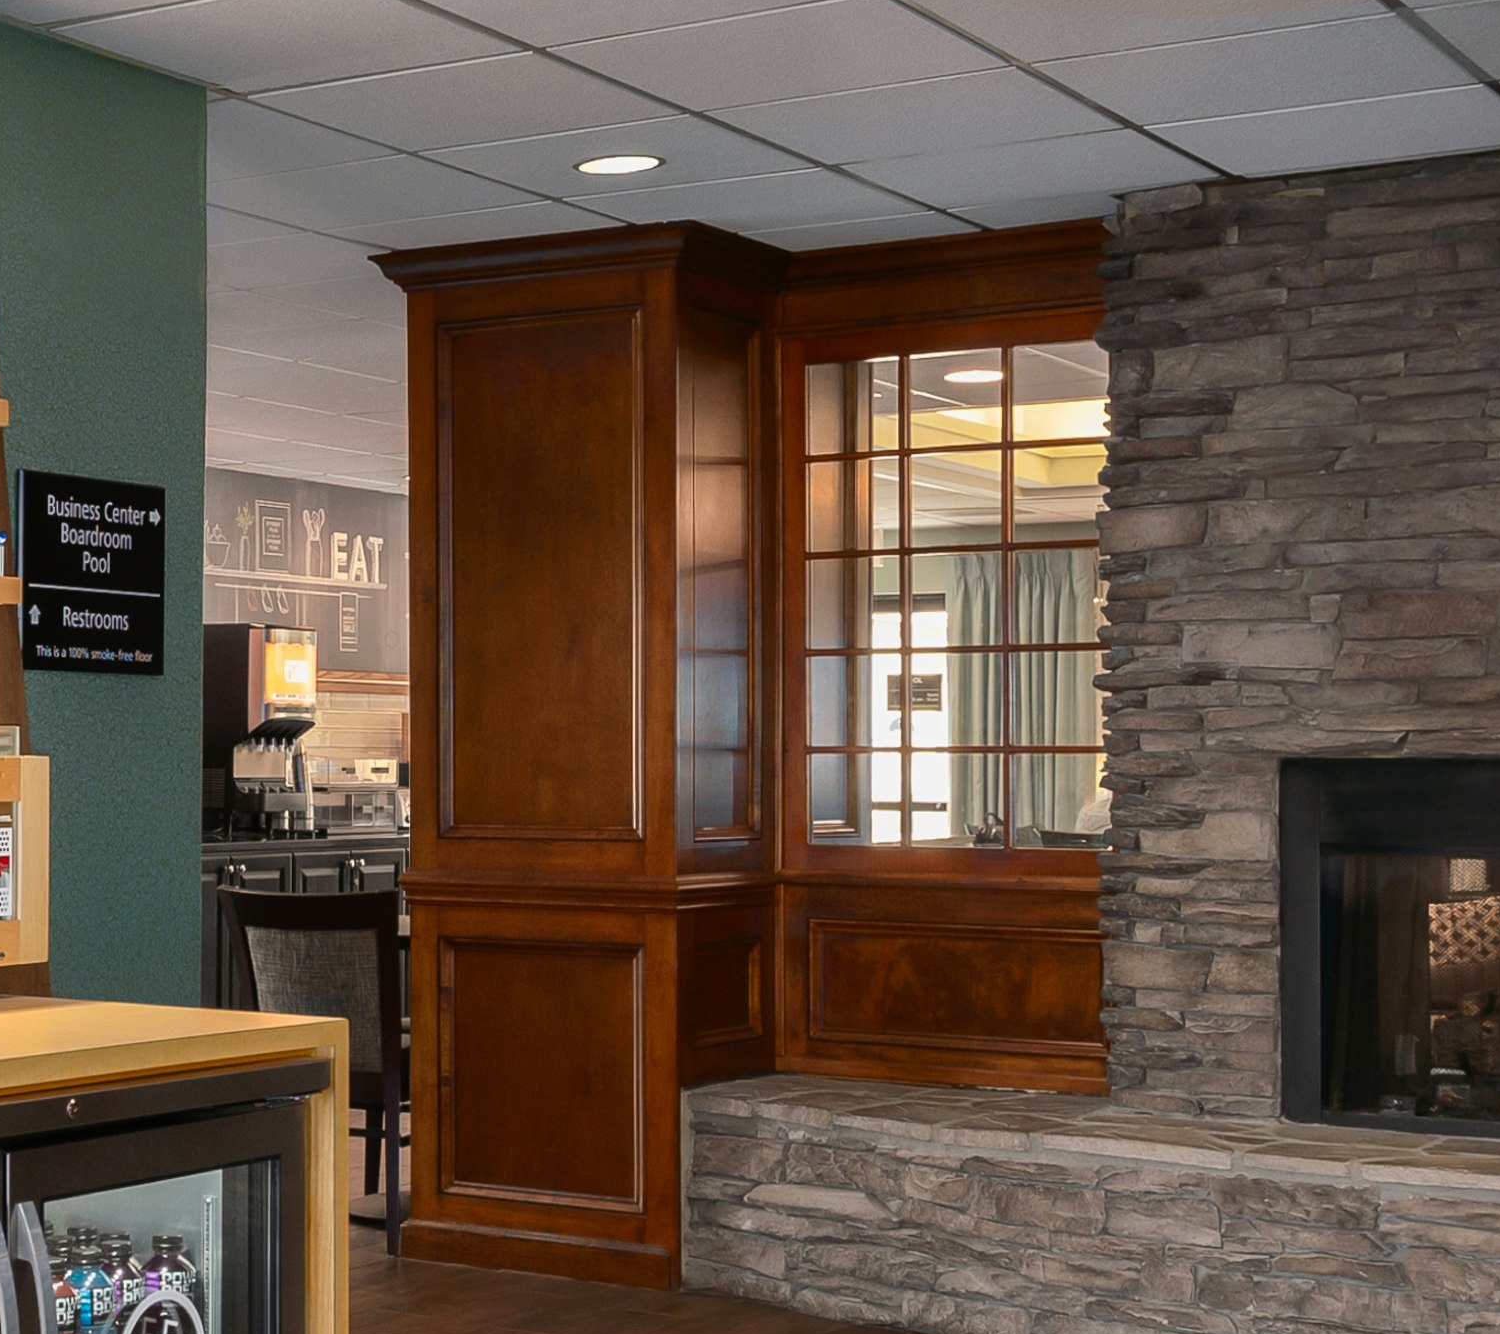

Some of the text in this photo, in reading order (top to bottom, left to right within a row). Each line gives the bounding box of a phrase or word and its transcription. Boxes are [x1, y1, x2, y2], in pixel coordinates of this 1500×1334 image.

[47, 494, 146, 526] Business Center
[60, 522, 133, 550] Boardroom
[82, 551, 111, 574] Pool
[330, 531, 384, 584] EAT
[63, 606, 129, 631] Restrooms
[36, 644, 153, 662] This is a 100% smoke-free floor
